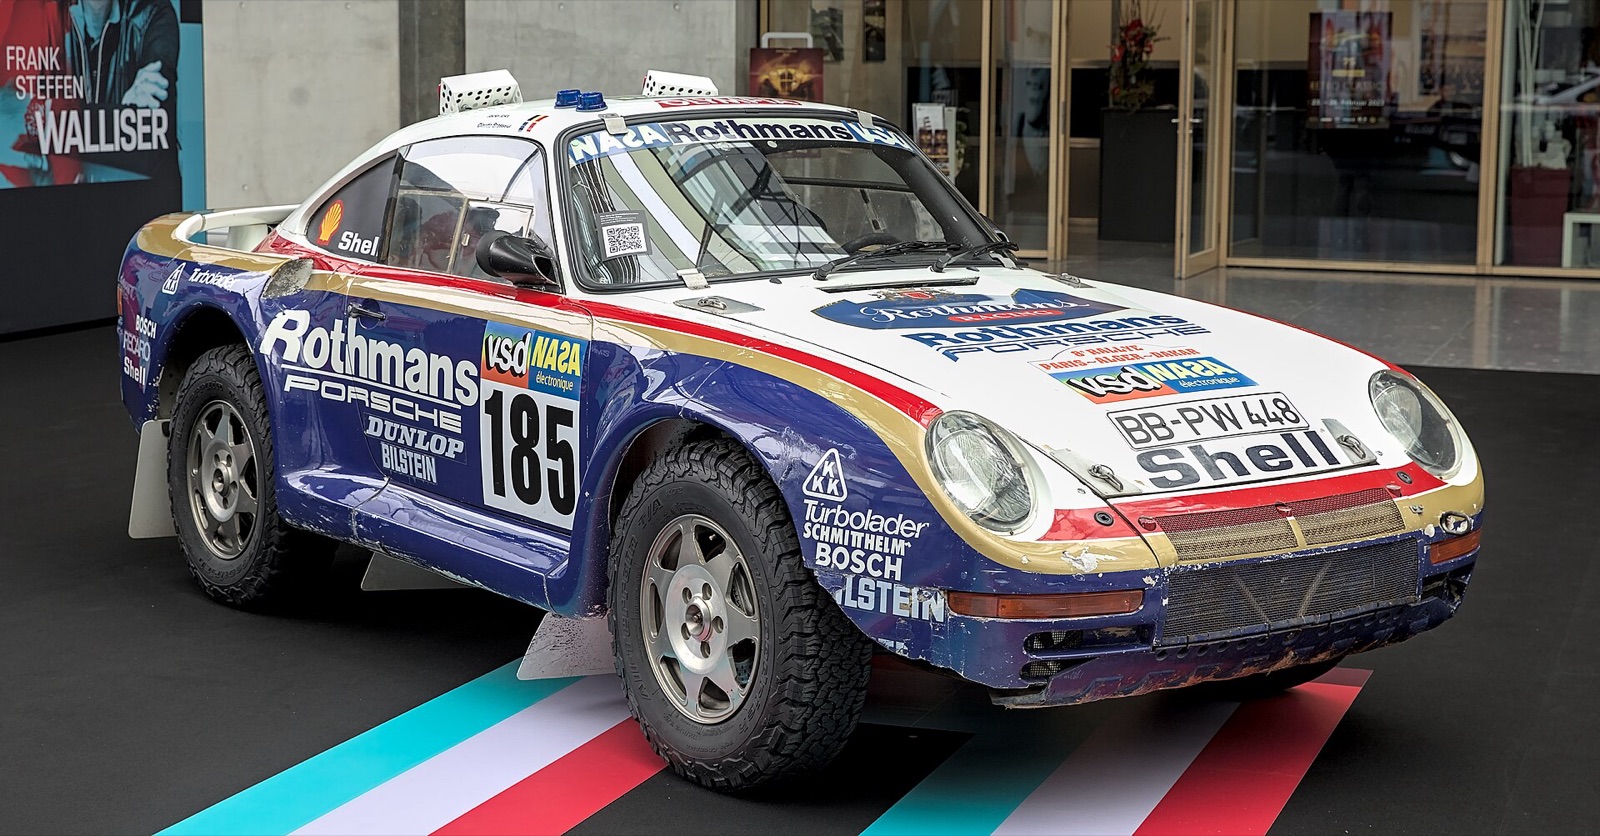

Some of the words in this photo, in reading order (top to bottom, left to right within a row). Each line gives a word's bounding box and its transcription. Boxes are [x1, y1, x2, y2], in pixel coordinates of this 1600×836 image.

[6, 46, 60, 71] FRANK
[15, 75, 84, 100] STEFFEN
[35, 108, 169, 155] WALLISER
[665, 119, 852, 145] Rothmans
[338, 231, 380, 257] Shel
[136, 314, 157, 339] BOSCH
[860, 298, 1090, 323] Rothmans
[901, 314, 1188, 346] Rothmans
[939, 326, 1211, 362] PORSCHE
[259, 309, 479, 407] Rothmans
[485, 331, 532, 378] vsd
[1086, 345, 1144, 356] RALLYE
[124, 357, 146, 385] Shell
[535, 370, 574, 392] électronique
[1066, 366, 1163, 397] vsd
[284, 374, 462, 434] PORSCHE
[1115, 403, 1239, 444] BB-PW
[1241, 397, 1301, 427] 448
[366, 415, 465, 458] DUNLOP
[484, 389, 576, 516] 185
[380, 442, 437, 484] BILSTEIN
[1136, 430, 1341, 489] Shell
[804, 499, 930, 539] Turbolader
[803, 523, 909, 556] SCHMITTHELM
[815, 543, 903, 581] BOSCH
